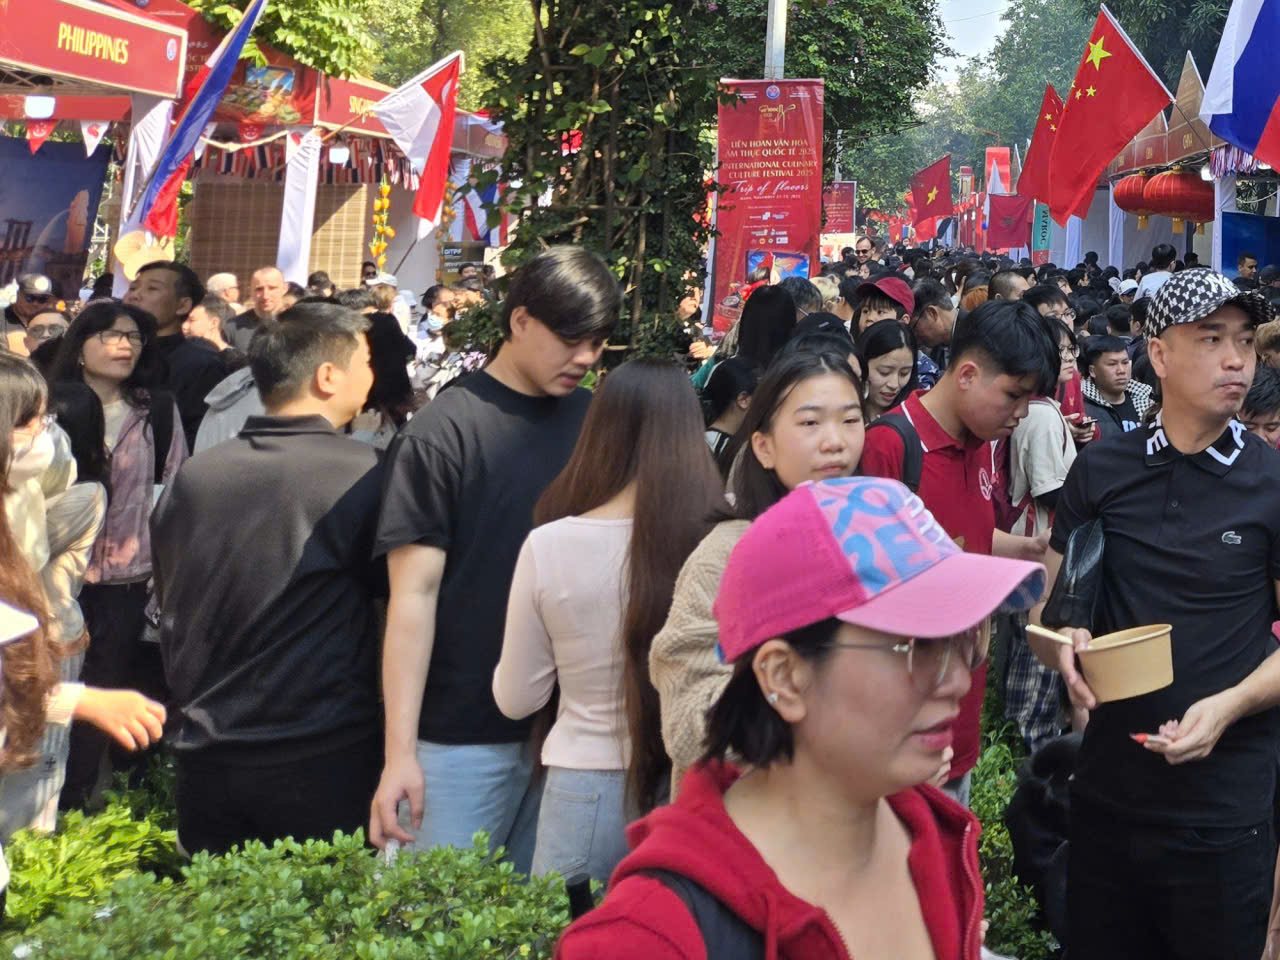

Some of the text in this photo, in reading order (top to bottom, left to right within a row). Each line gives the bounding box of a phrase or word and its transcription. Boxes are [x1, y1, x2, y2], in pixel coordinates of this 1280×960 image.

[57, 21, 129, 65] PHILIPPINES
[722, 160, 818, 170] INTERNATIONAL CULINARY
[728, 171, 761, 179] CULTURE
[762, 169, 794, 178] FESTIVAL
[730, 180, 809, 196] Trip of flavors
